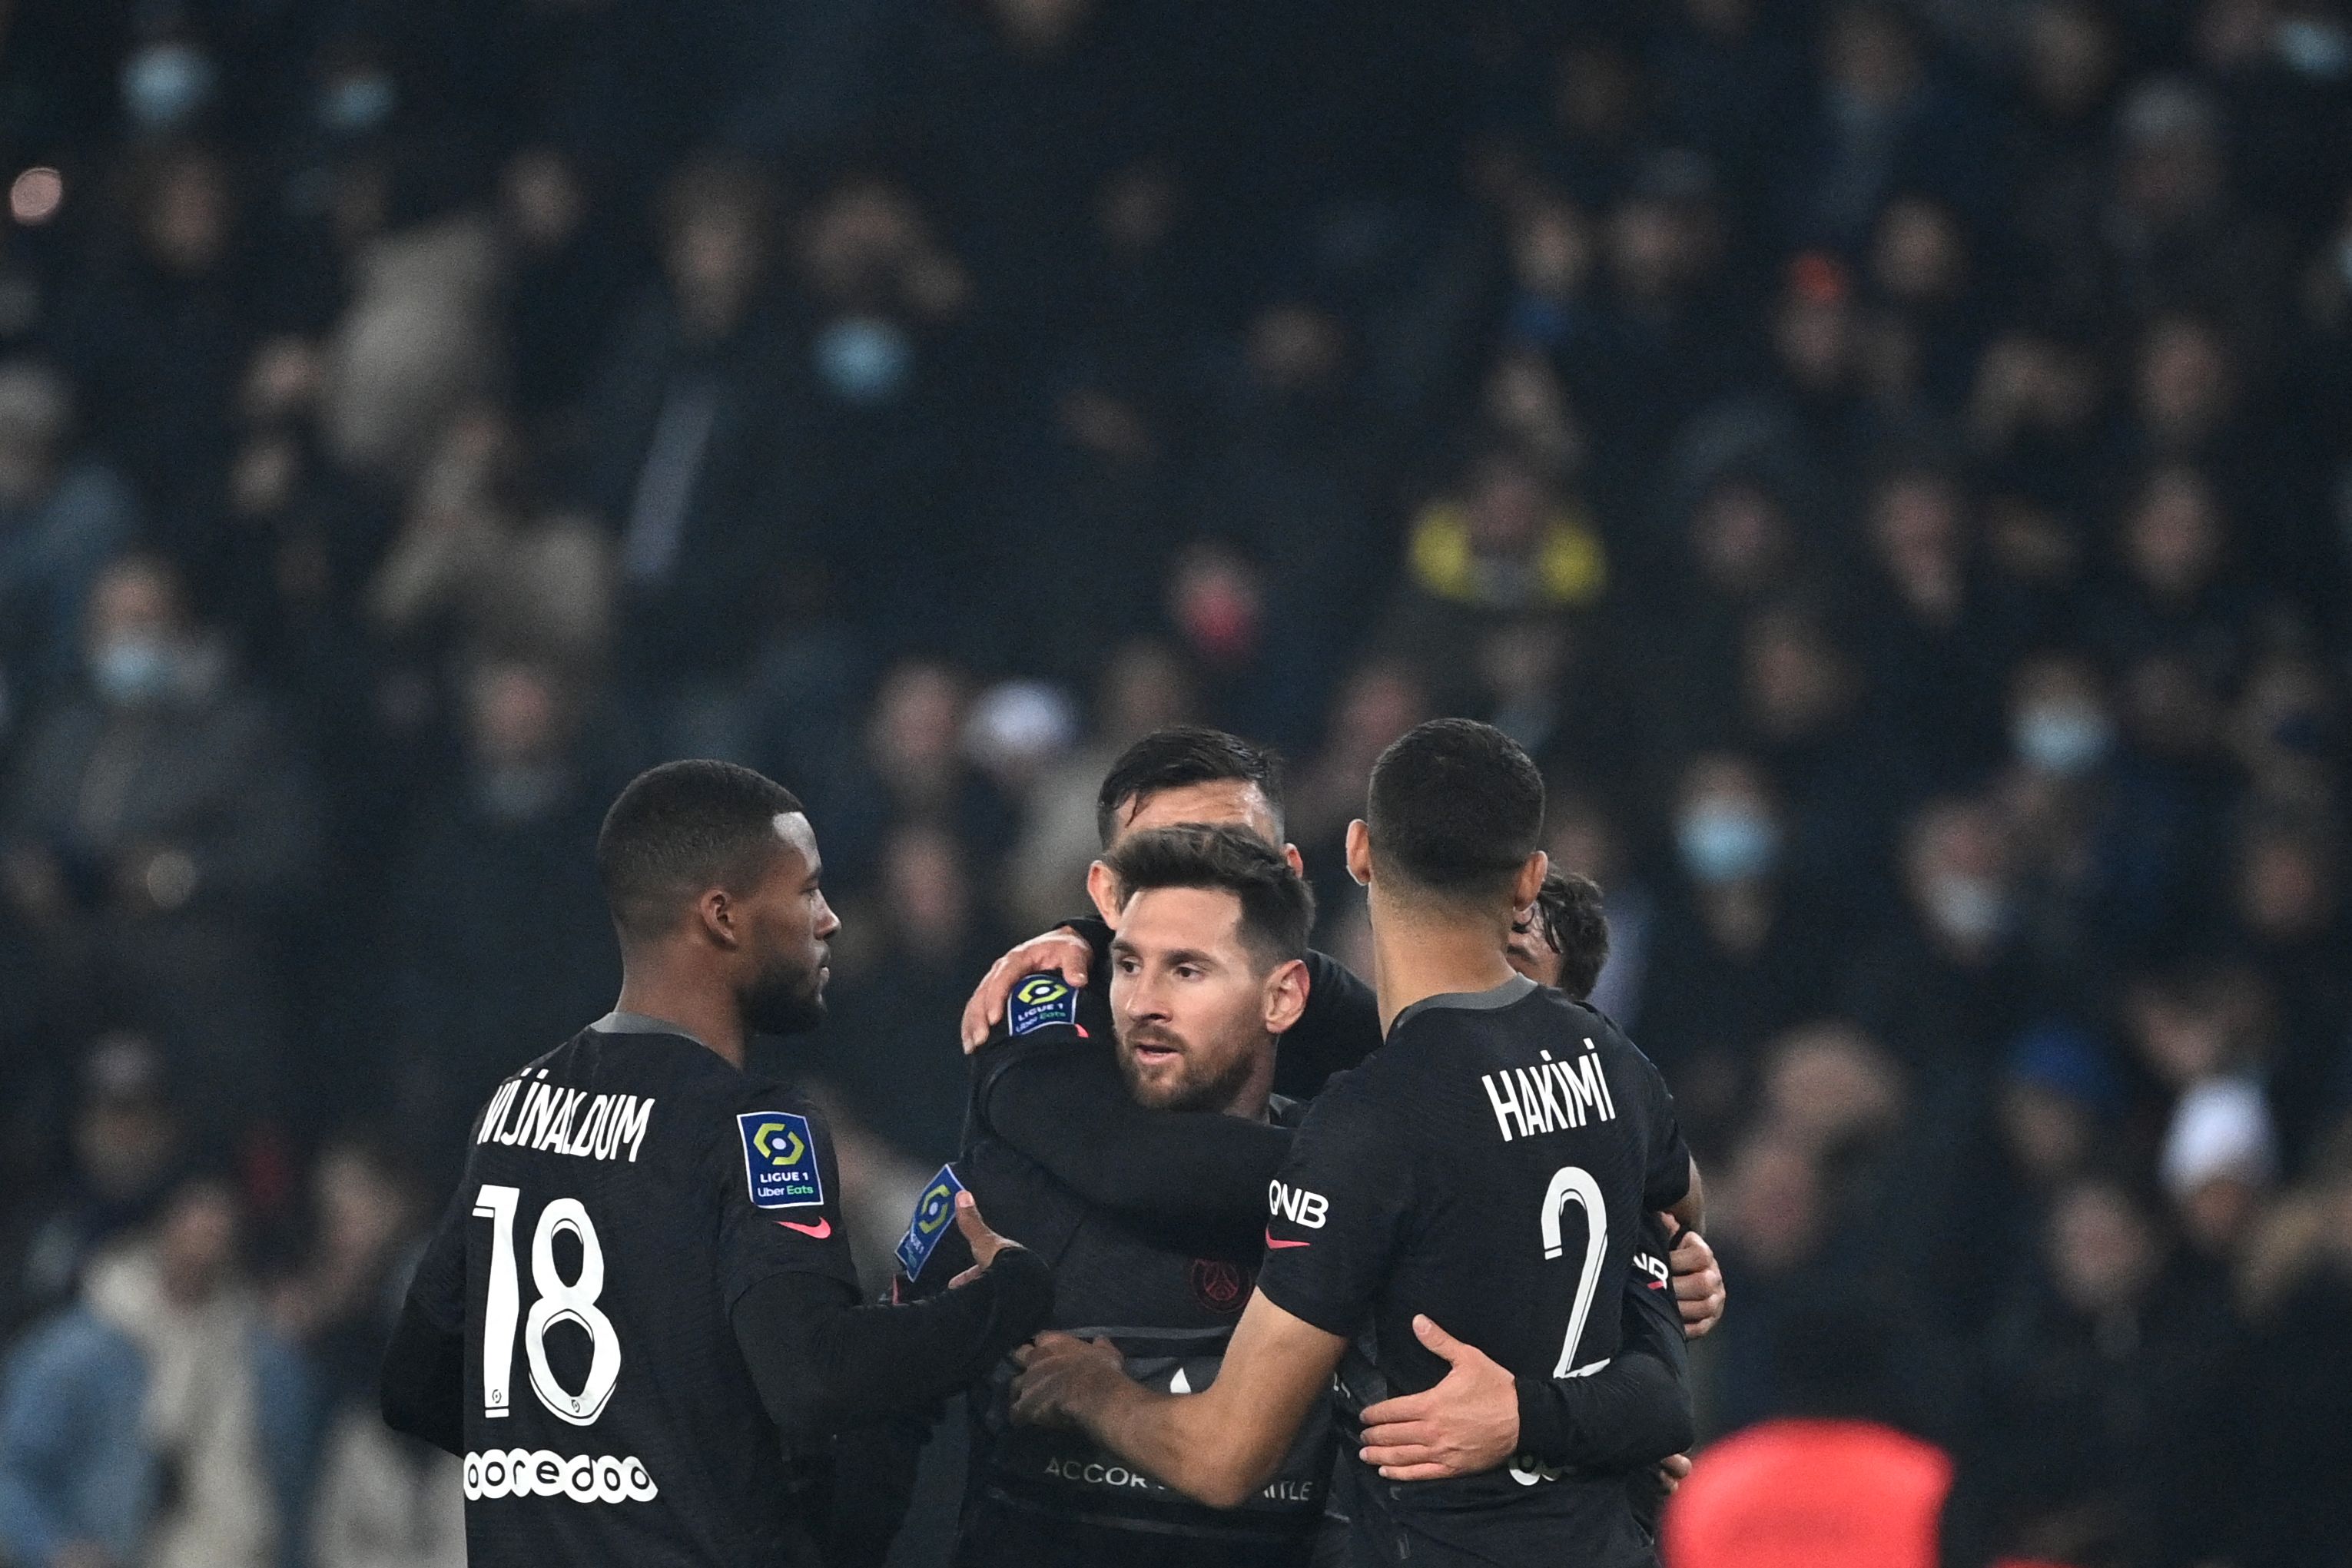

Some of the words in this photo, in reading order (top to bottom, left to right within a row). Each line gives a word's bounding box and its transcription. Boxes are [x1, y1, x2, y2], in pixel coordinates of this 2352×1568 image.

[758, 1187, 785, 1197] Uber
[786, 1185, 814, 1195] Eats
[760, 1172, 800, 1183] LIGUE
[802, 1172, 809, 1181] 1
[1269, 1179, 1329, 1229] QNB
[1541, 1166, 1610, 1379] 2
[473, 1185, 621, 1426] 18
[464, 1450, 657, 1501] ooredoo
